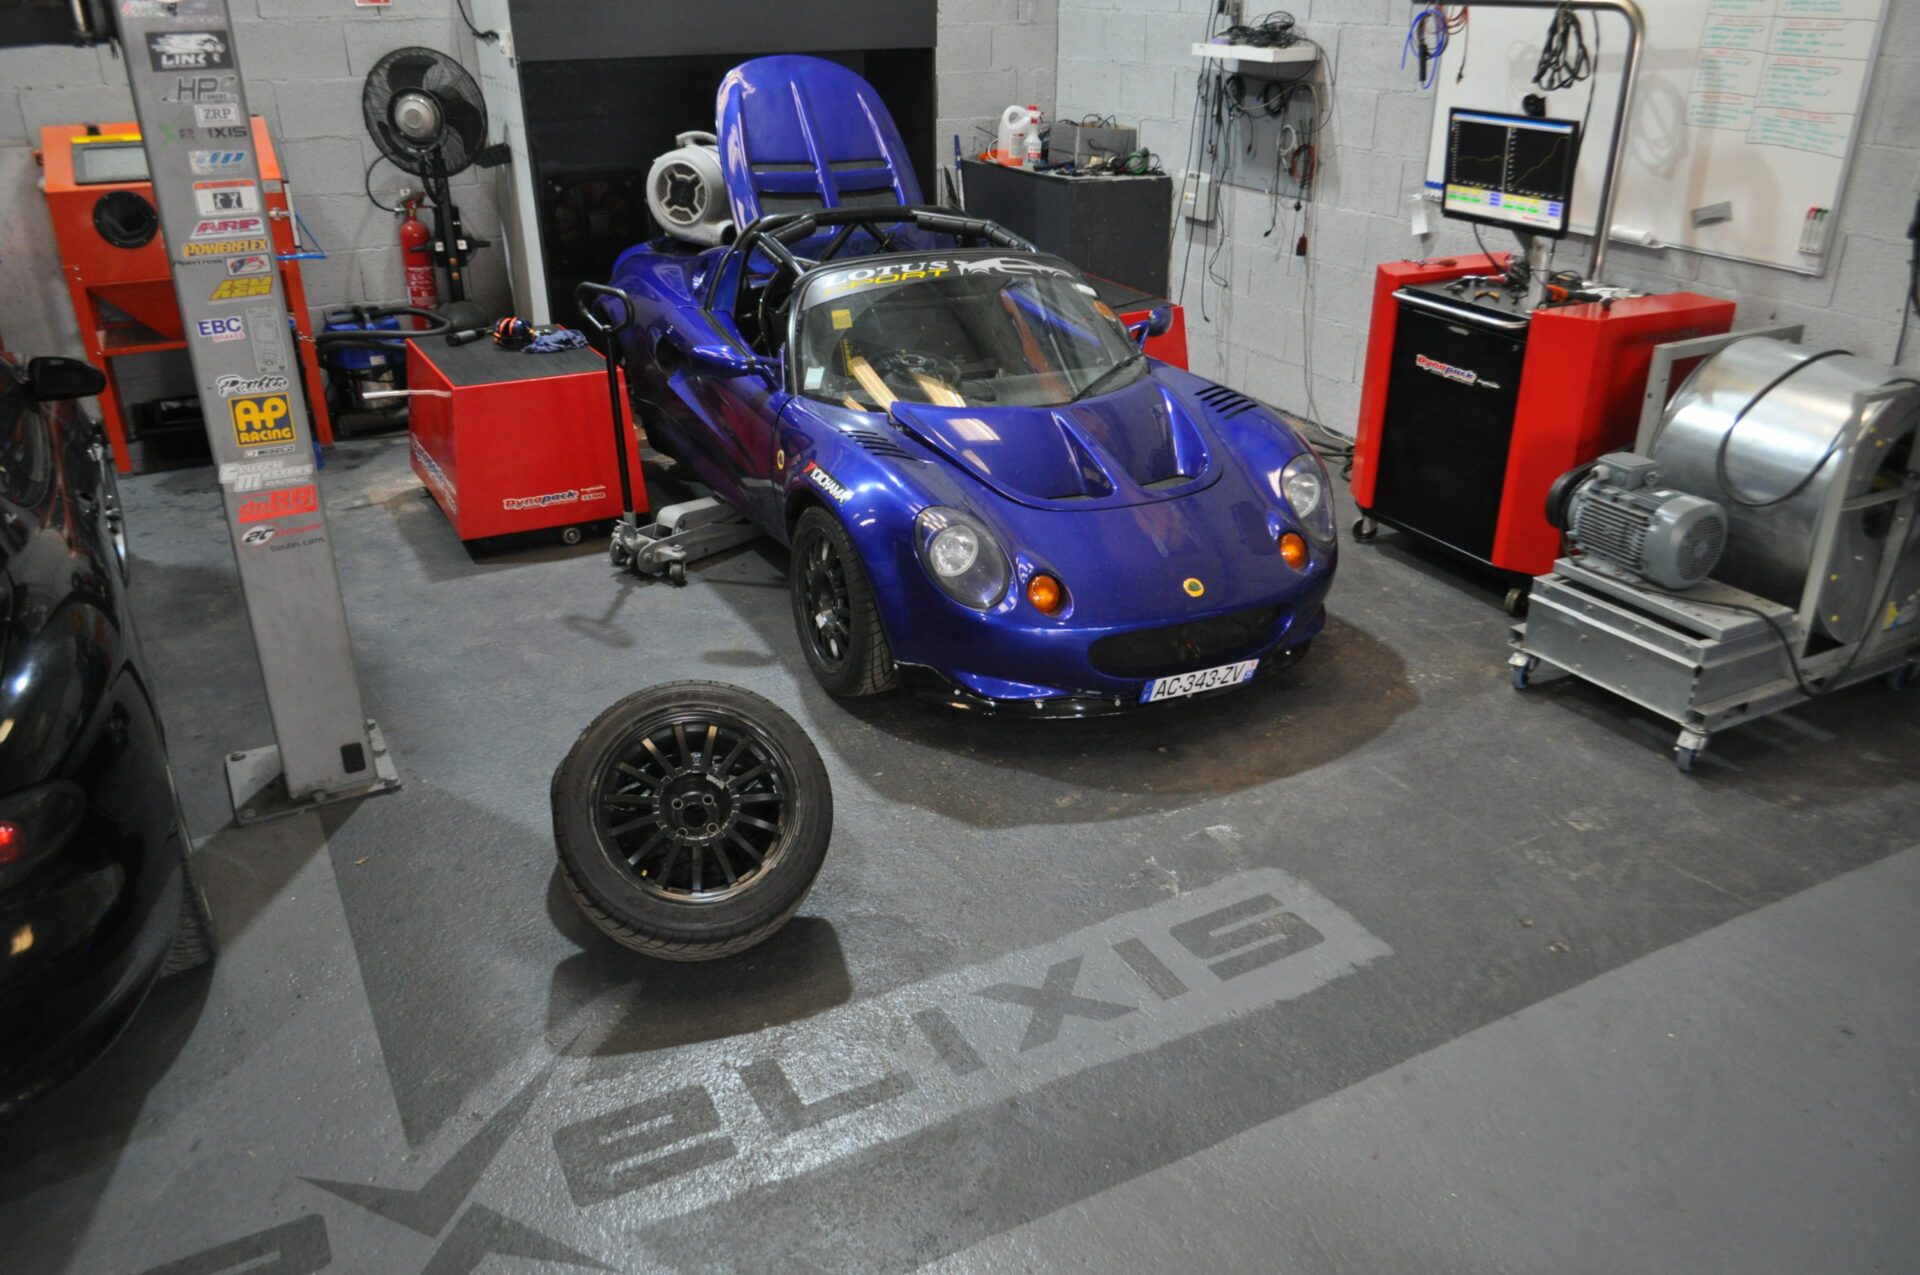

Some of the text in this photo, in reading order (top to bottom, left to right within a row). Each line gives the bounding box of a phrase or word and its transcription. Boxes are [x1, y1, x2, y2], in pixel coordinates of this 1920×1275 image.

[178, 77, 217, 100] HP
[203, 107, 231, 119] ZRP
[197, 218, 261, 233] ARP
[198, 317, 242, 336] EBC
[234, 397, 288, 431] AP
[240, 427, 292, 444] RACING
[503, 490, 579, 511] Dynapack
[1154, 662, 1247, 699] AC-343-ZV
